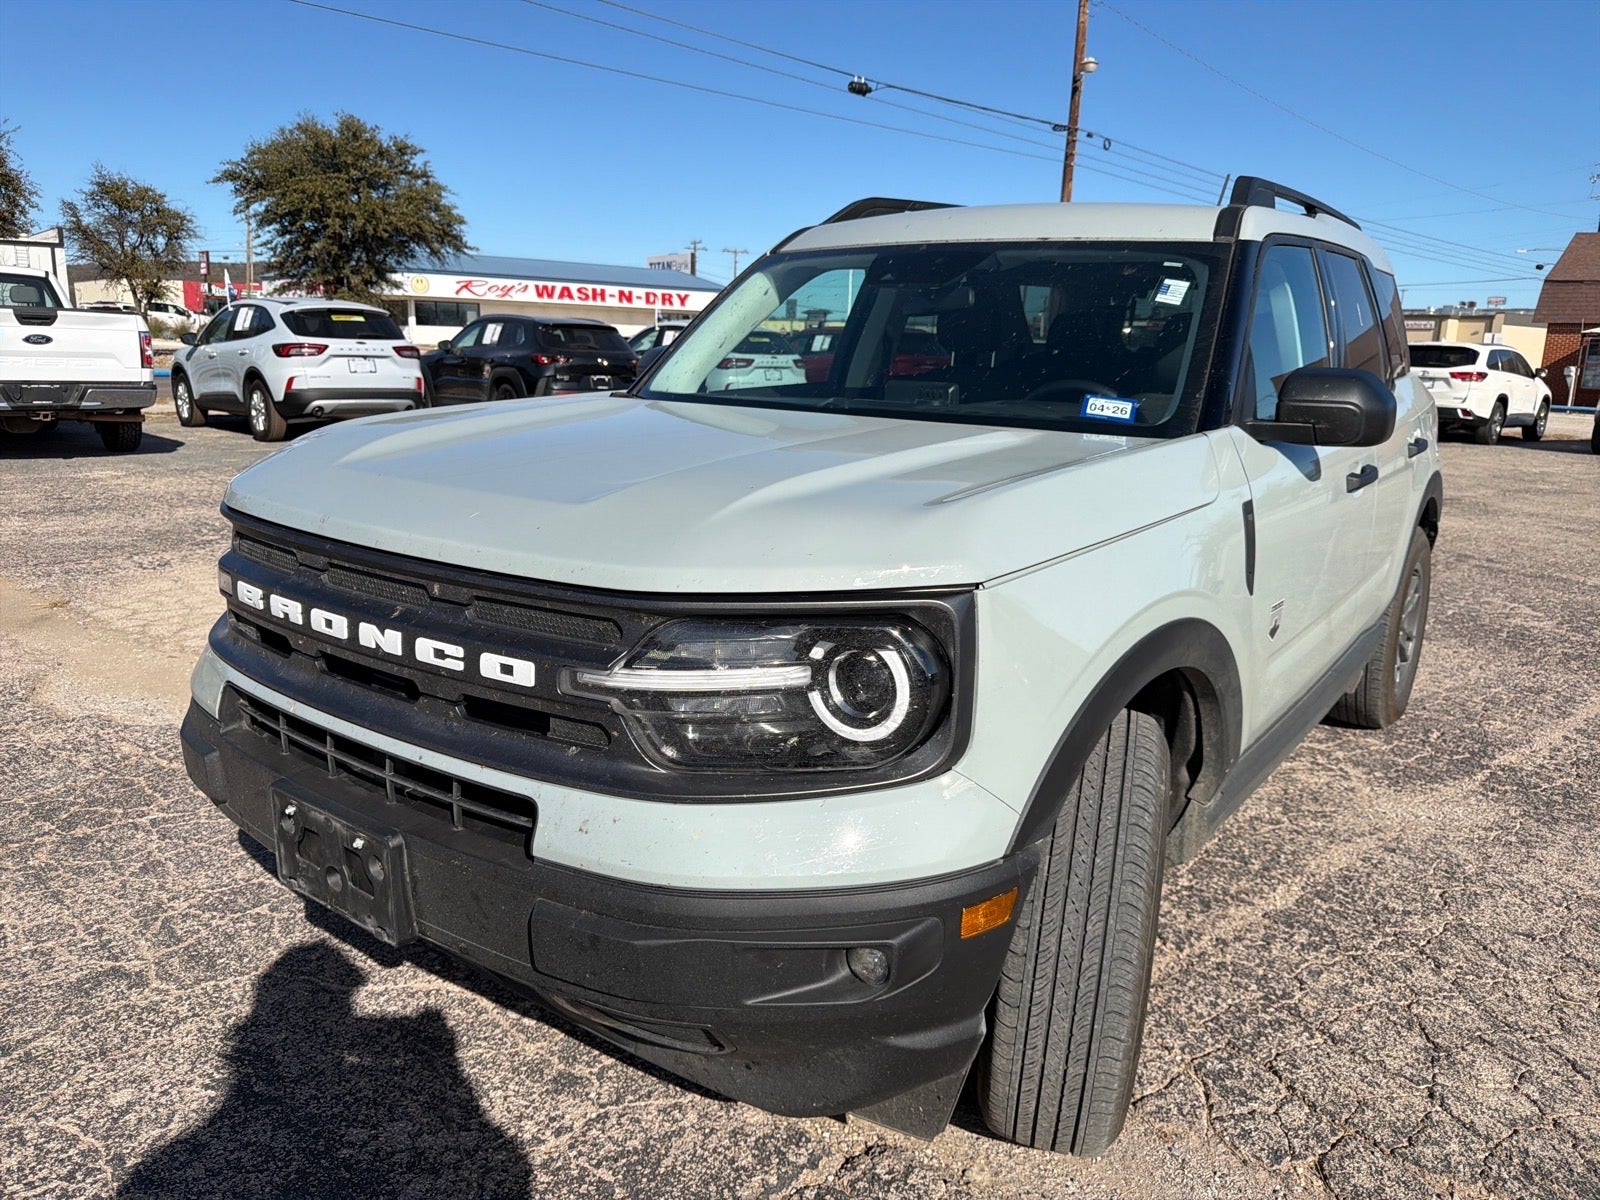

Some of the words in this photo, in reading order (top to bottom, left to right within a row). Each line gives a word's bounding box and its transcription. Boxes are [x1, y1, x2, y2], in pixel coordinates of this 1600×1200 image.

[455, 279, 528, 299] Roy's
[534, 284, 690, 307] WASH-N-DRY
[1089, 402, 1105, 412] 04
[1111, 405, 1128, 416] 26
[236, 580, 536, 687] BRONCO
